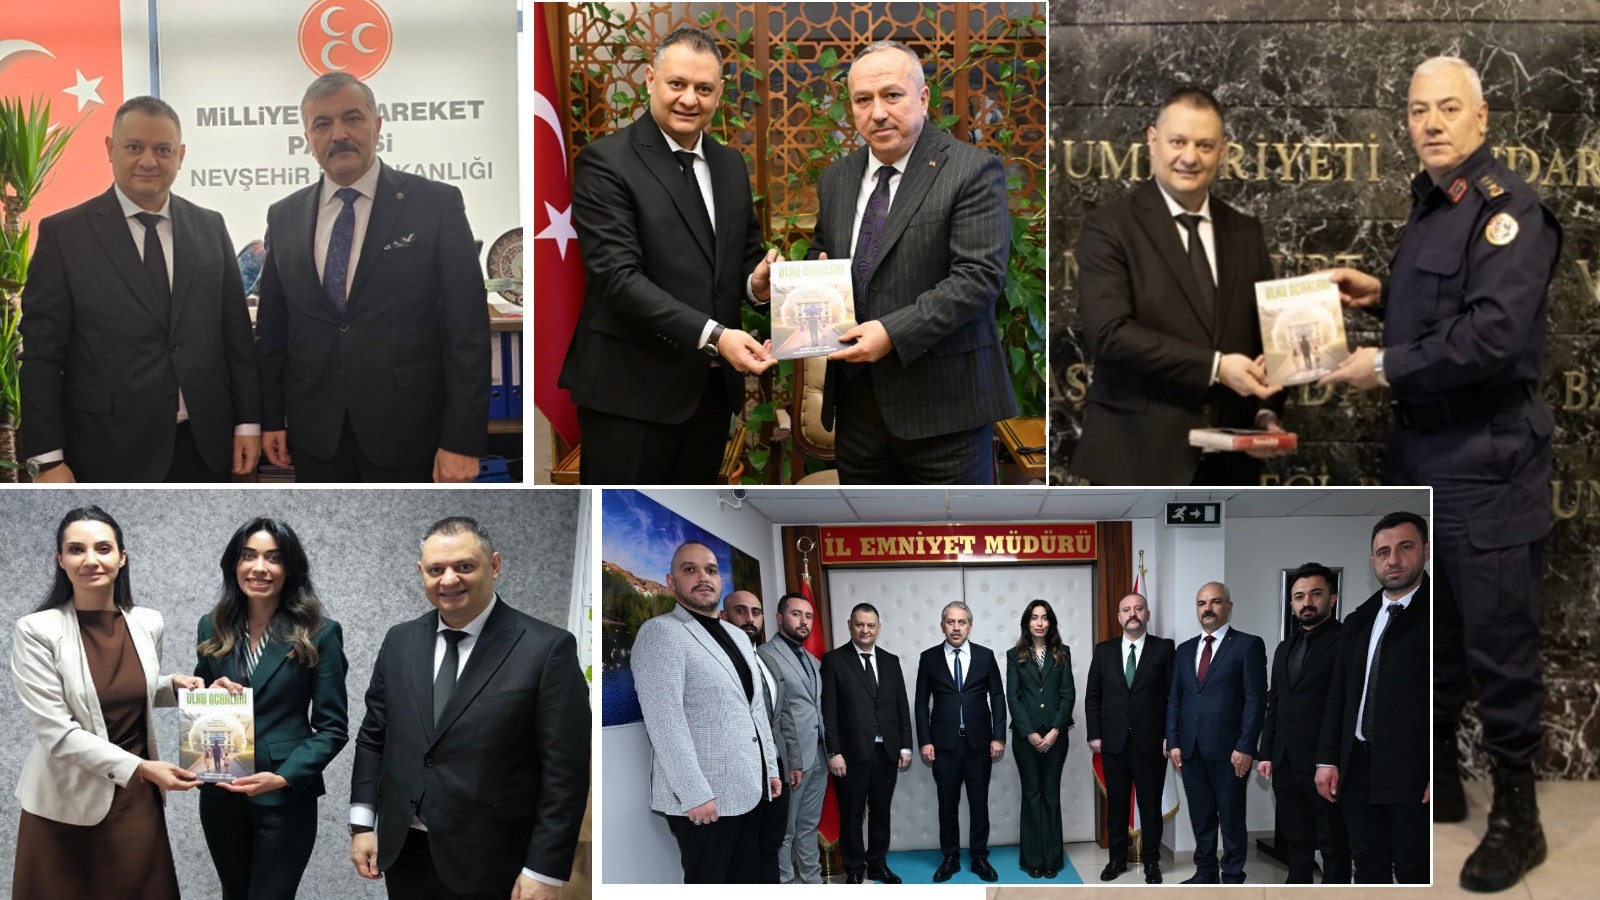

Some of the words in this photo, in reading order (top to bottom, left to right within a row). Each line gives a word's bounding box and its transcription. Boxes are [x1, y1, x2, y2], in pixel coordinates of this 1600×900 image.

[196, 105, 299, 127] MiLLiYE
[375, 100, 485, 122] AREKET
[825, 532, 851, 557] İL
[859, 530, 976, 556] EMNİYET
[984, 529, 1092, 554] MÜDÜRÜ
